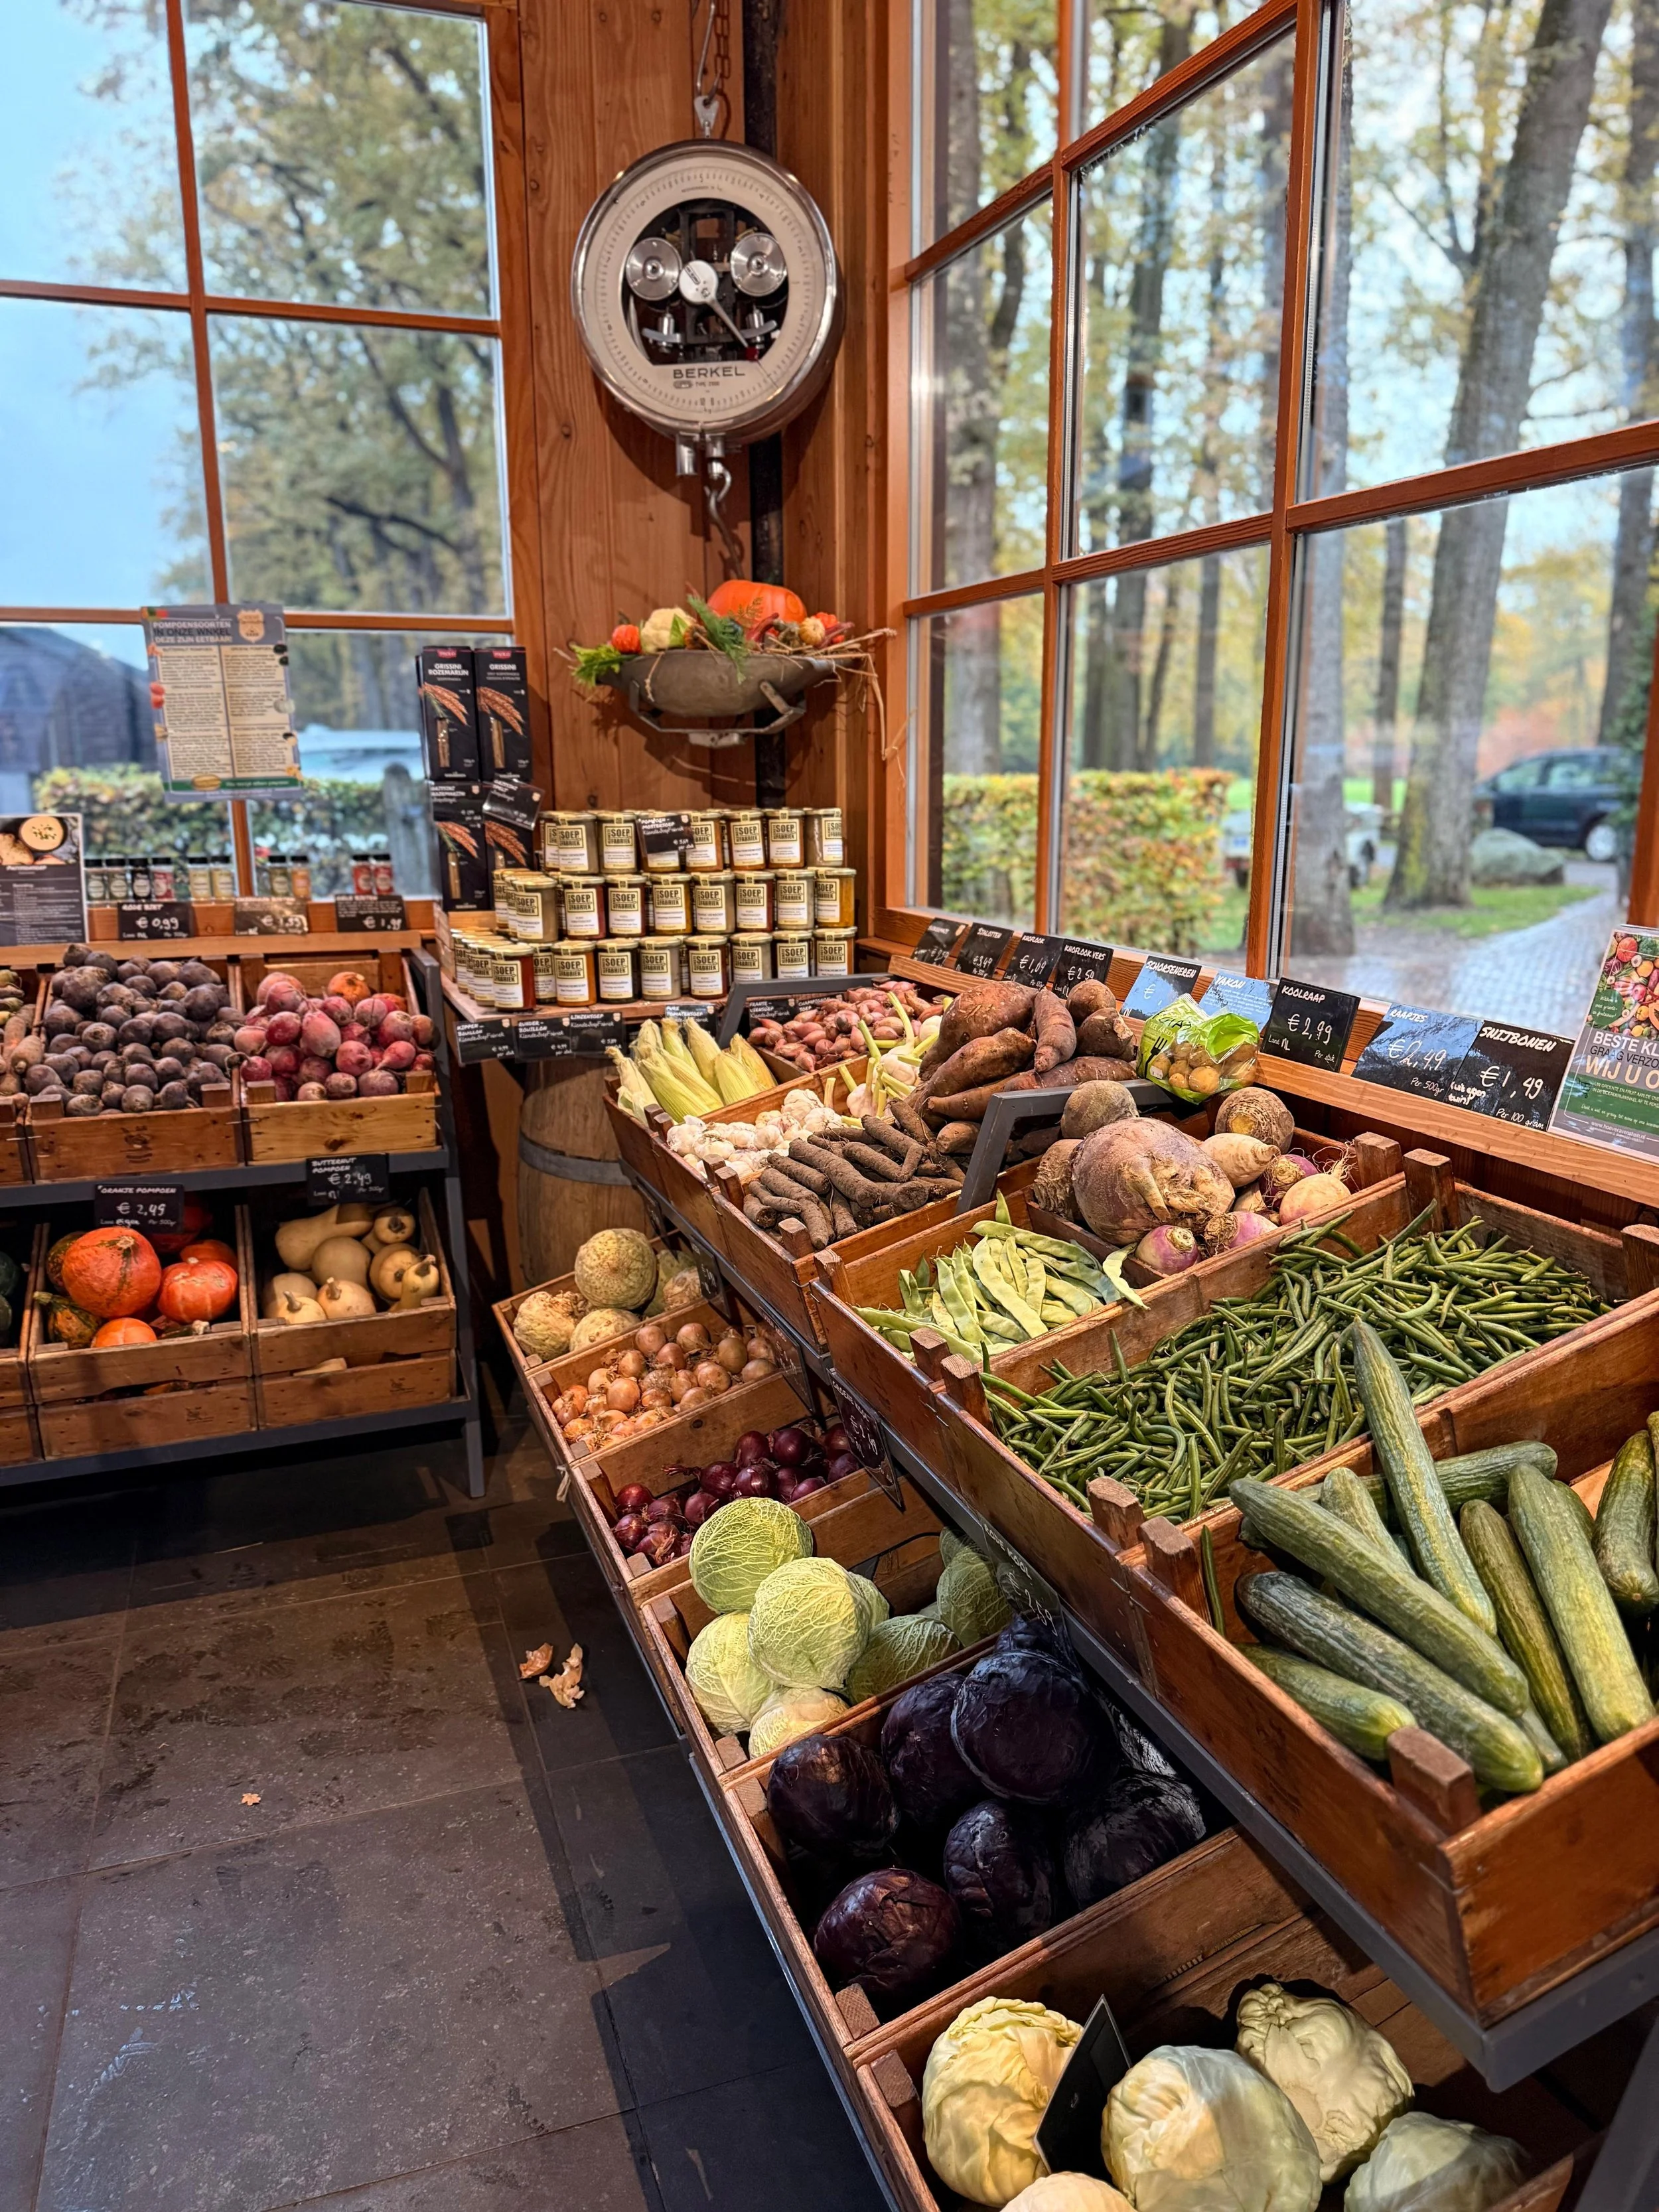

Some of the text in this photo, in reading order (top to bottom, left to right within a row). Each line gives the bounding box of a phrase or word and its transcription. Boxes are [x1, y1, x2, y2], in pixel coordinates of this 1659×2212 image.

[673, 366, 745, 379] BERKEL
[561, 830, 579, 839] SOEP
[611, 828, 630, 837] SOEP
[518, 898, 534, 907] SOEP
[571, 894, 591, 903] SOEP
[135, 917, 148, 928] €
[1022, 935, 1045, 944] KNOFLOOK
[696, 954, 716, 963] SOEP
[737, 951, 756, 960] SOEP
[1064, 944, 1106, 961] KNOFLOOK VERS
[495, 964, 514, 974] SOEP
[561, 960, 580, 969] SOEP
[605, 958, 625, 966] SOEP
[1019, 955, 1029, 969] €
[1067, 966, 1076, 980] €
[1145, 960, 1197, 979] SCHORSENEREN
[1215, 976, 1246, 990] YAKON
[1282, 986, 1325, 1003] KOOLRAAP
[1390, 1009, 1427, 1023] RAAPJES
[1287, 1013, 1333, 1045] € 2,99
[1268, 1035, 1280, 1045] Land
[1281, 1038, 1291, 1051] NL
[1479, 1027, 1557, 1052] SNIJBONEN
[1593, 1031, 1659, 1057] BESTE KL
[1388, 1039, 1405, 1059] €
[1590, 1046, 1659, 1069] GRAAG VERZO
[1480, 1066, 1500, 1087] €
[1585, 1055, 1659, 1089] WIJ U O
[1411, 1077, 1444, 1096] Per 500gr
[1496, 1108, 1544, 1129] Per 100 gram
[311, 1157, 356, 1167] BUTTERNUT
[327, 1173, 340, 1185] €
[116, 1202, 130, 1215] €
[984, 1523, 1033, 1580] RODE KOOL
